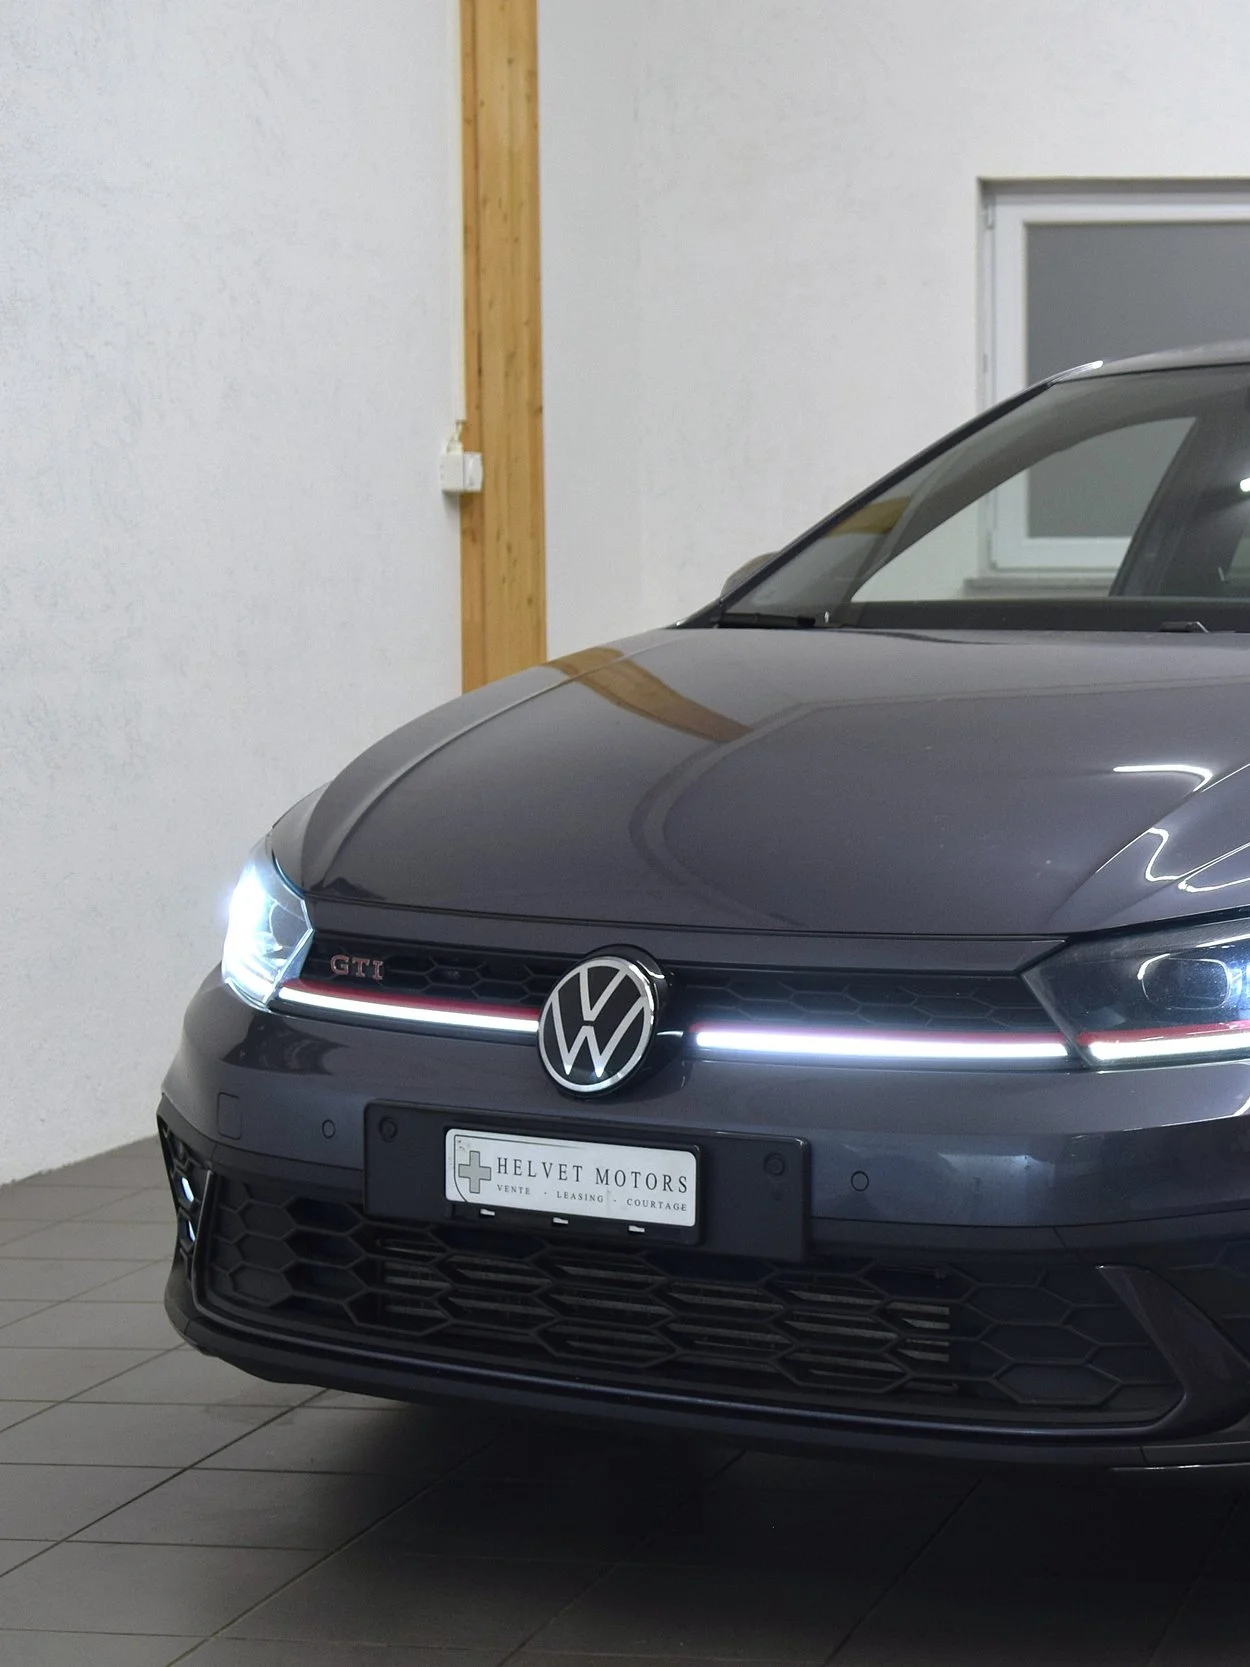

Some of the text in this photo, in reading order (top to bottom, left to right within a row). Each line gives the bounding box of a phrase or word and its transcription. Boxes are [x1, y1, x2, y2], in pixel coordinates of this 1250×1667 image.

[330, 954, 384, 981] GTI
[497, 1156, 688, 1194] HELVET MOTORS
[496, 1184, 687, 1212] VENTE LEASING COURTAGE
